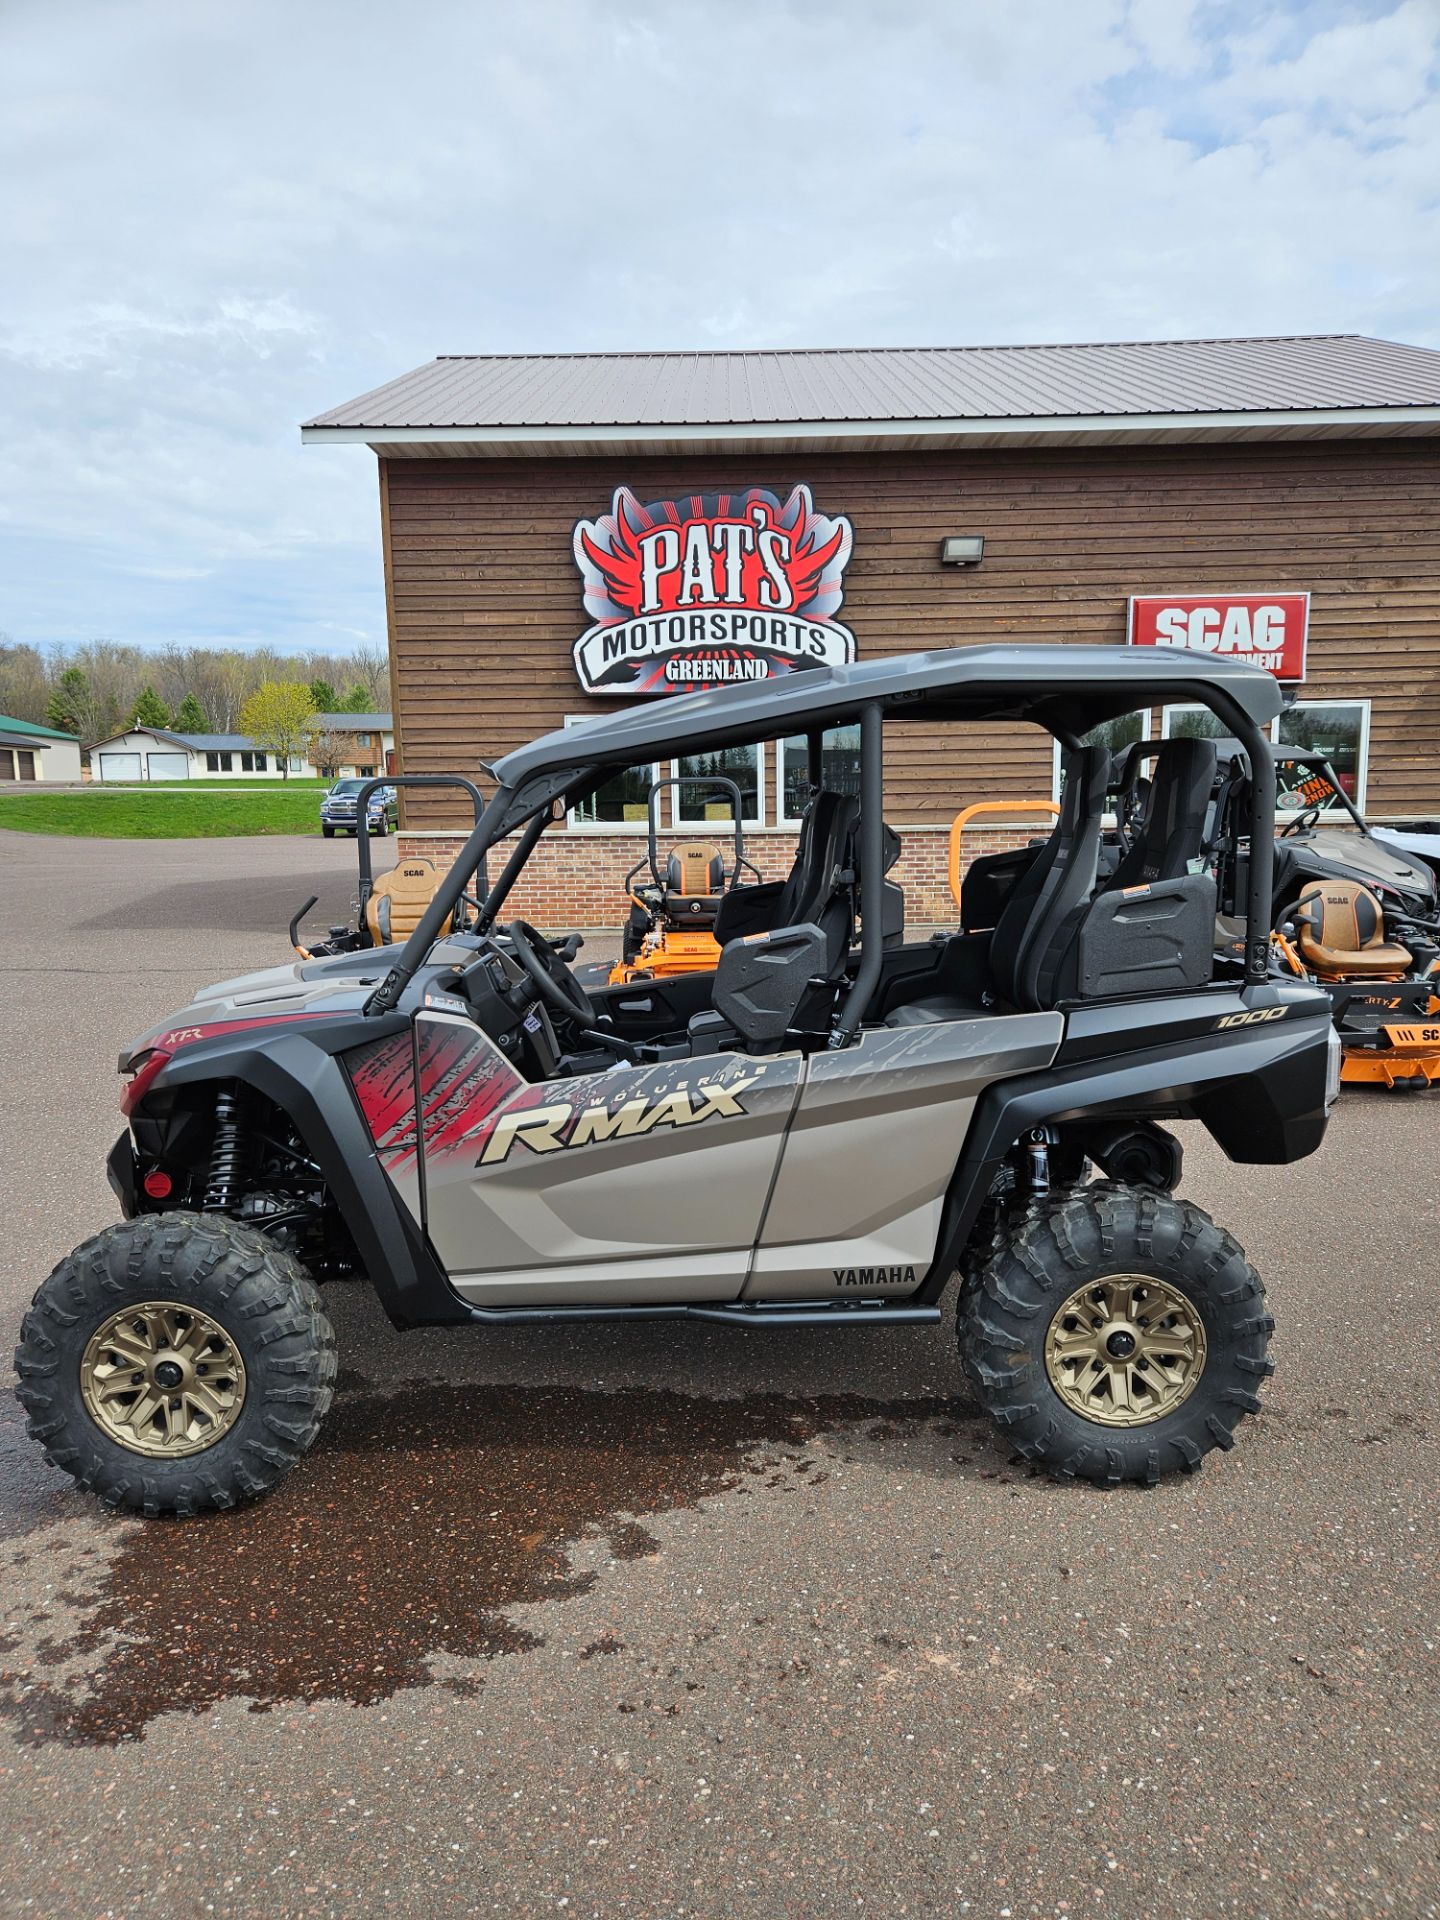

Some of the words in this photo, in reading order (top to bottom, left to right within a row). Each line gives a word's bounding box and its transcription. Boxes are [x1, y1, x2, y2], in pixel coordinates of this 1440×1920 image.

[640, 508, 793, 613] PAT'S
[602, 614, 827, 663] MOTORSPORTS
[1156, 605, 1286, 652] SCAG
[665, 658, 769, 681] GREENLAND
[403, 869, 424, 877] SCAG
[1327, 897, 1349, 905] SCAG
[1217, 1005, 1289, 1028] 1000
[1422, 1029, 1440, 1041] SC
[476, 1076, 760, 1166] RMAX
[832, 1265, 916, 1287] YAMAHA
